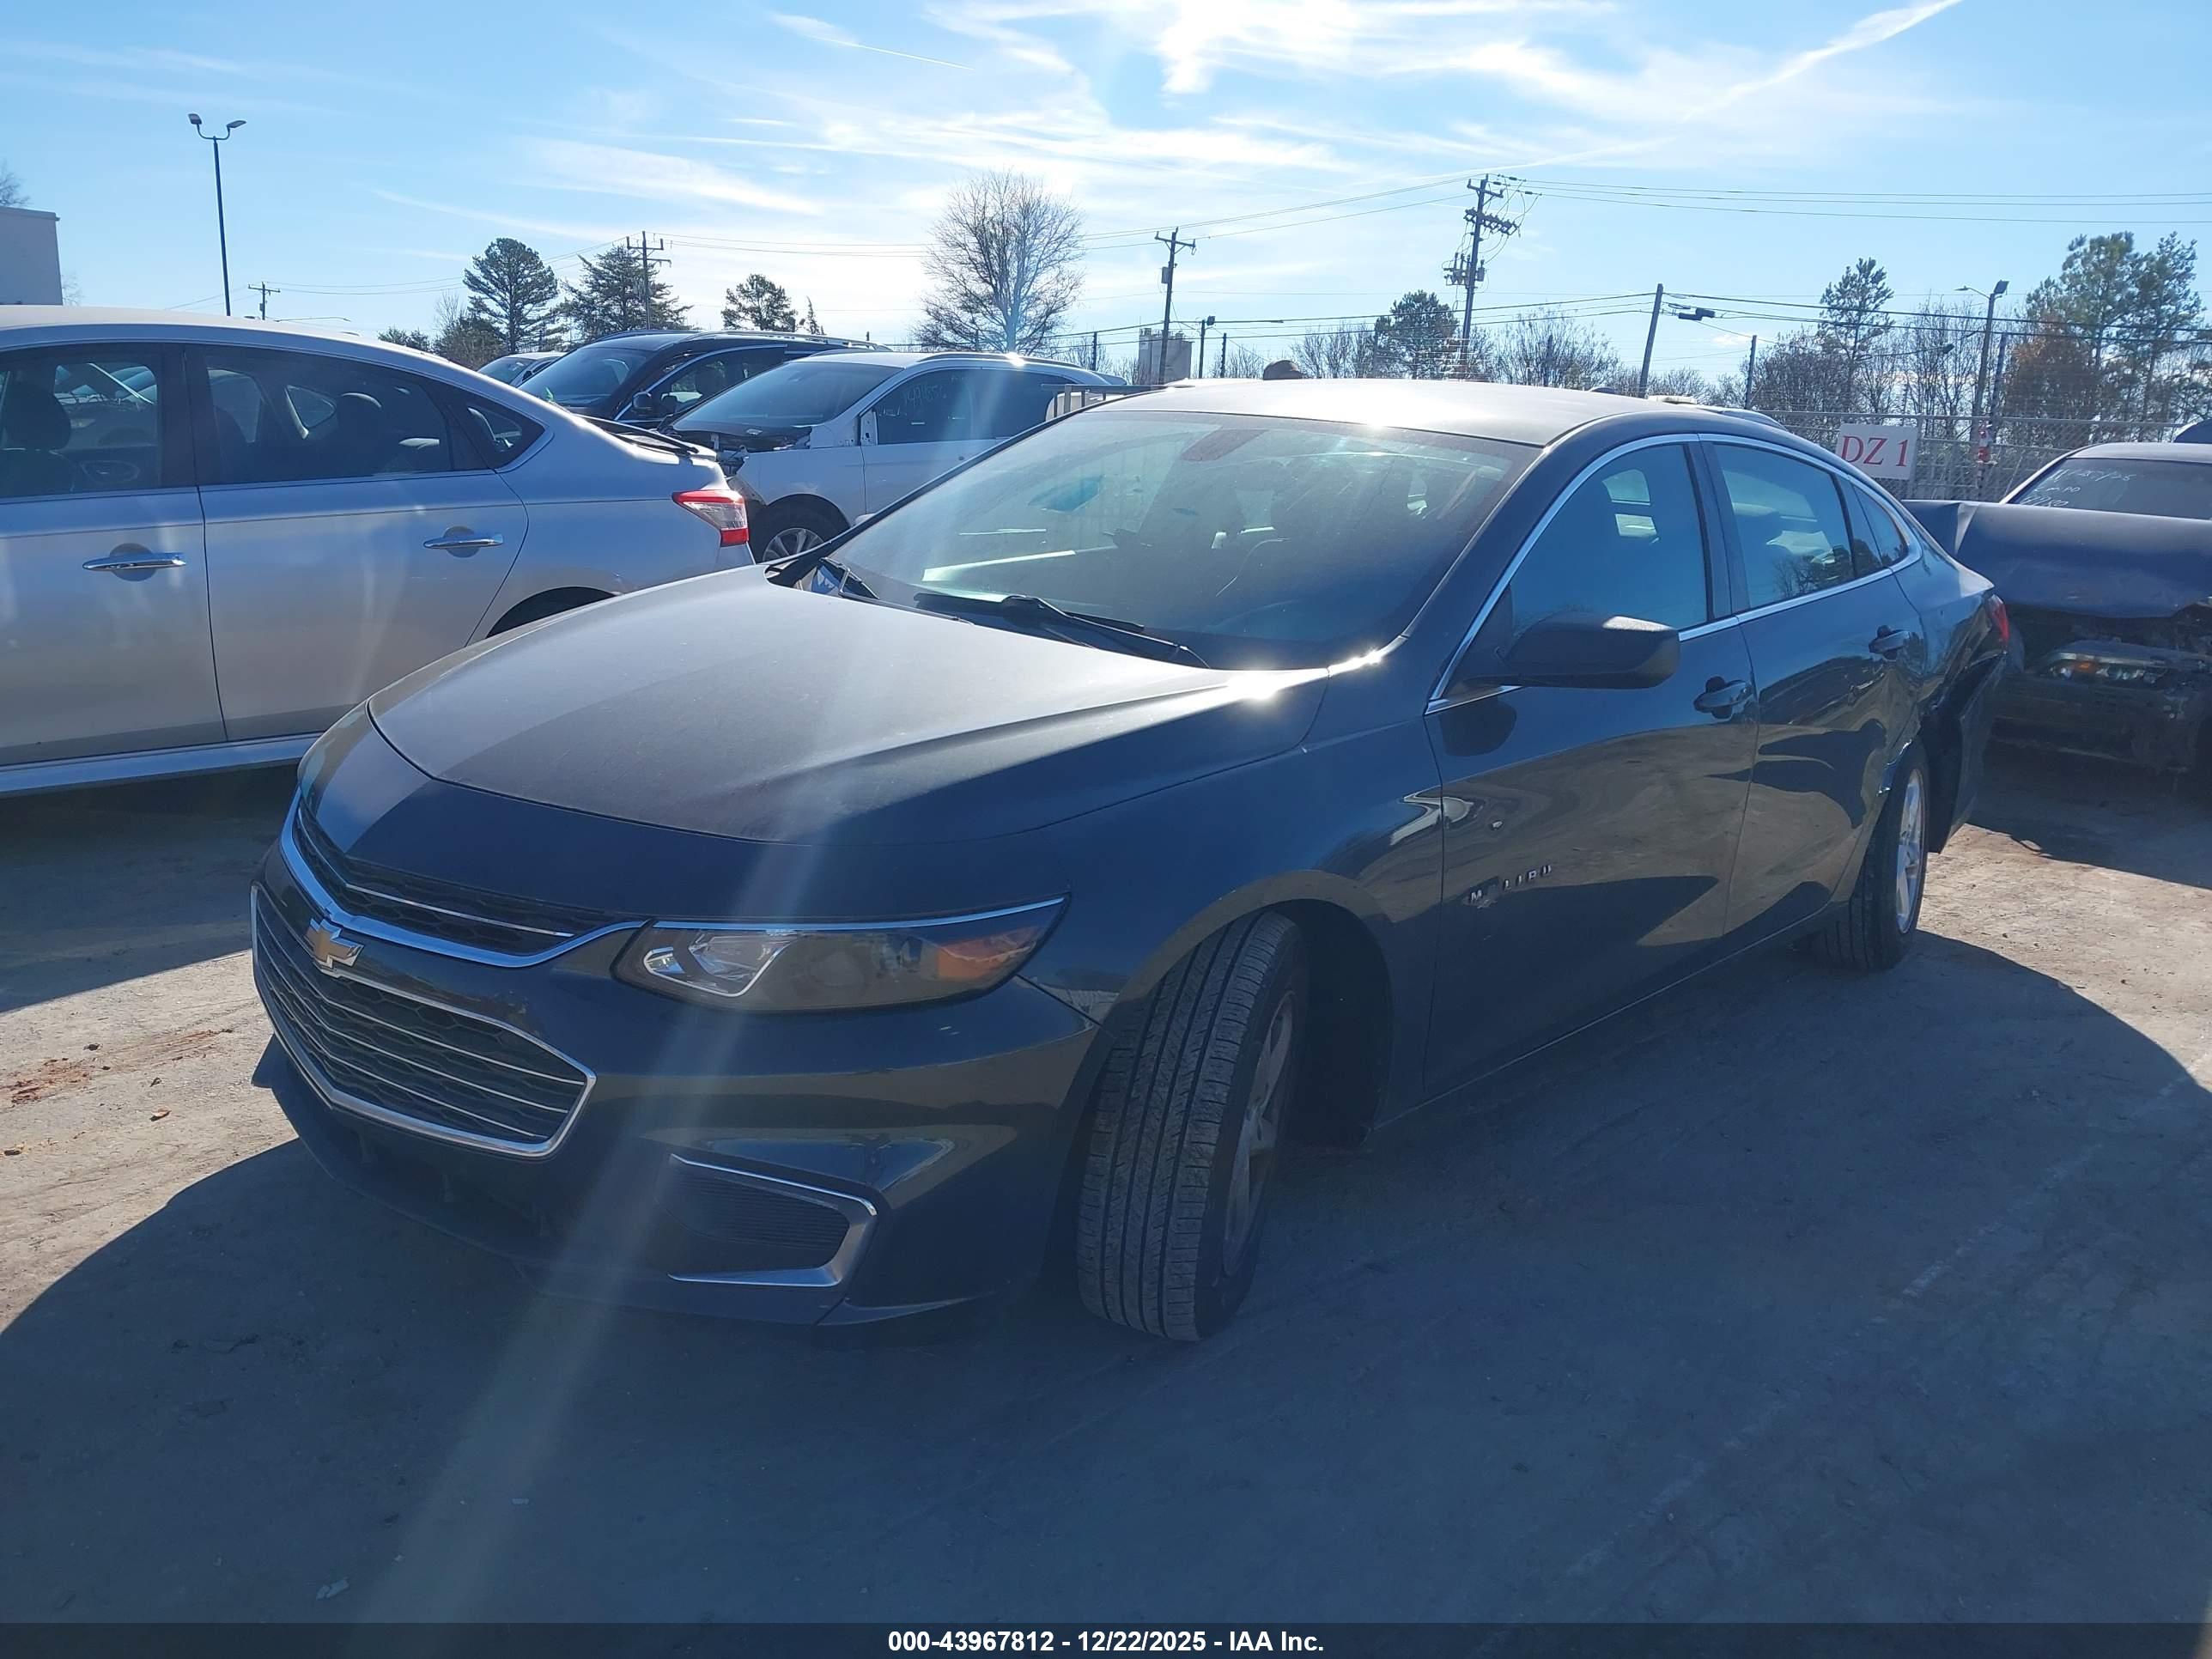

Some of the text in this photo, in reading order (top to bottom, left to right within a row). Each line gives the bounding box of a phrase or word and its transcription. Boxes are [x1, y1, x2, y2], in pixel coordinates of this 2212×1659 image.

[1840, 435, 1909, 467] DZ 1
[1470, 865, 1552, 901] MLIBU
